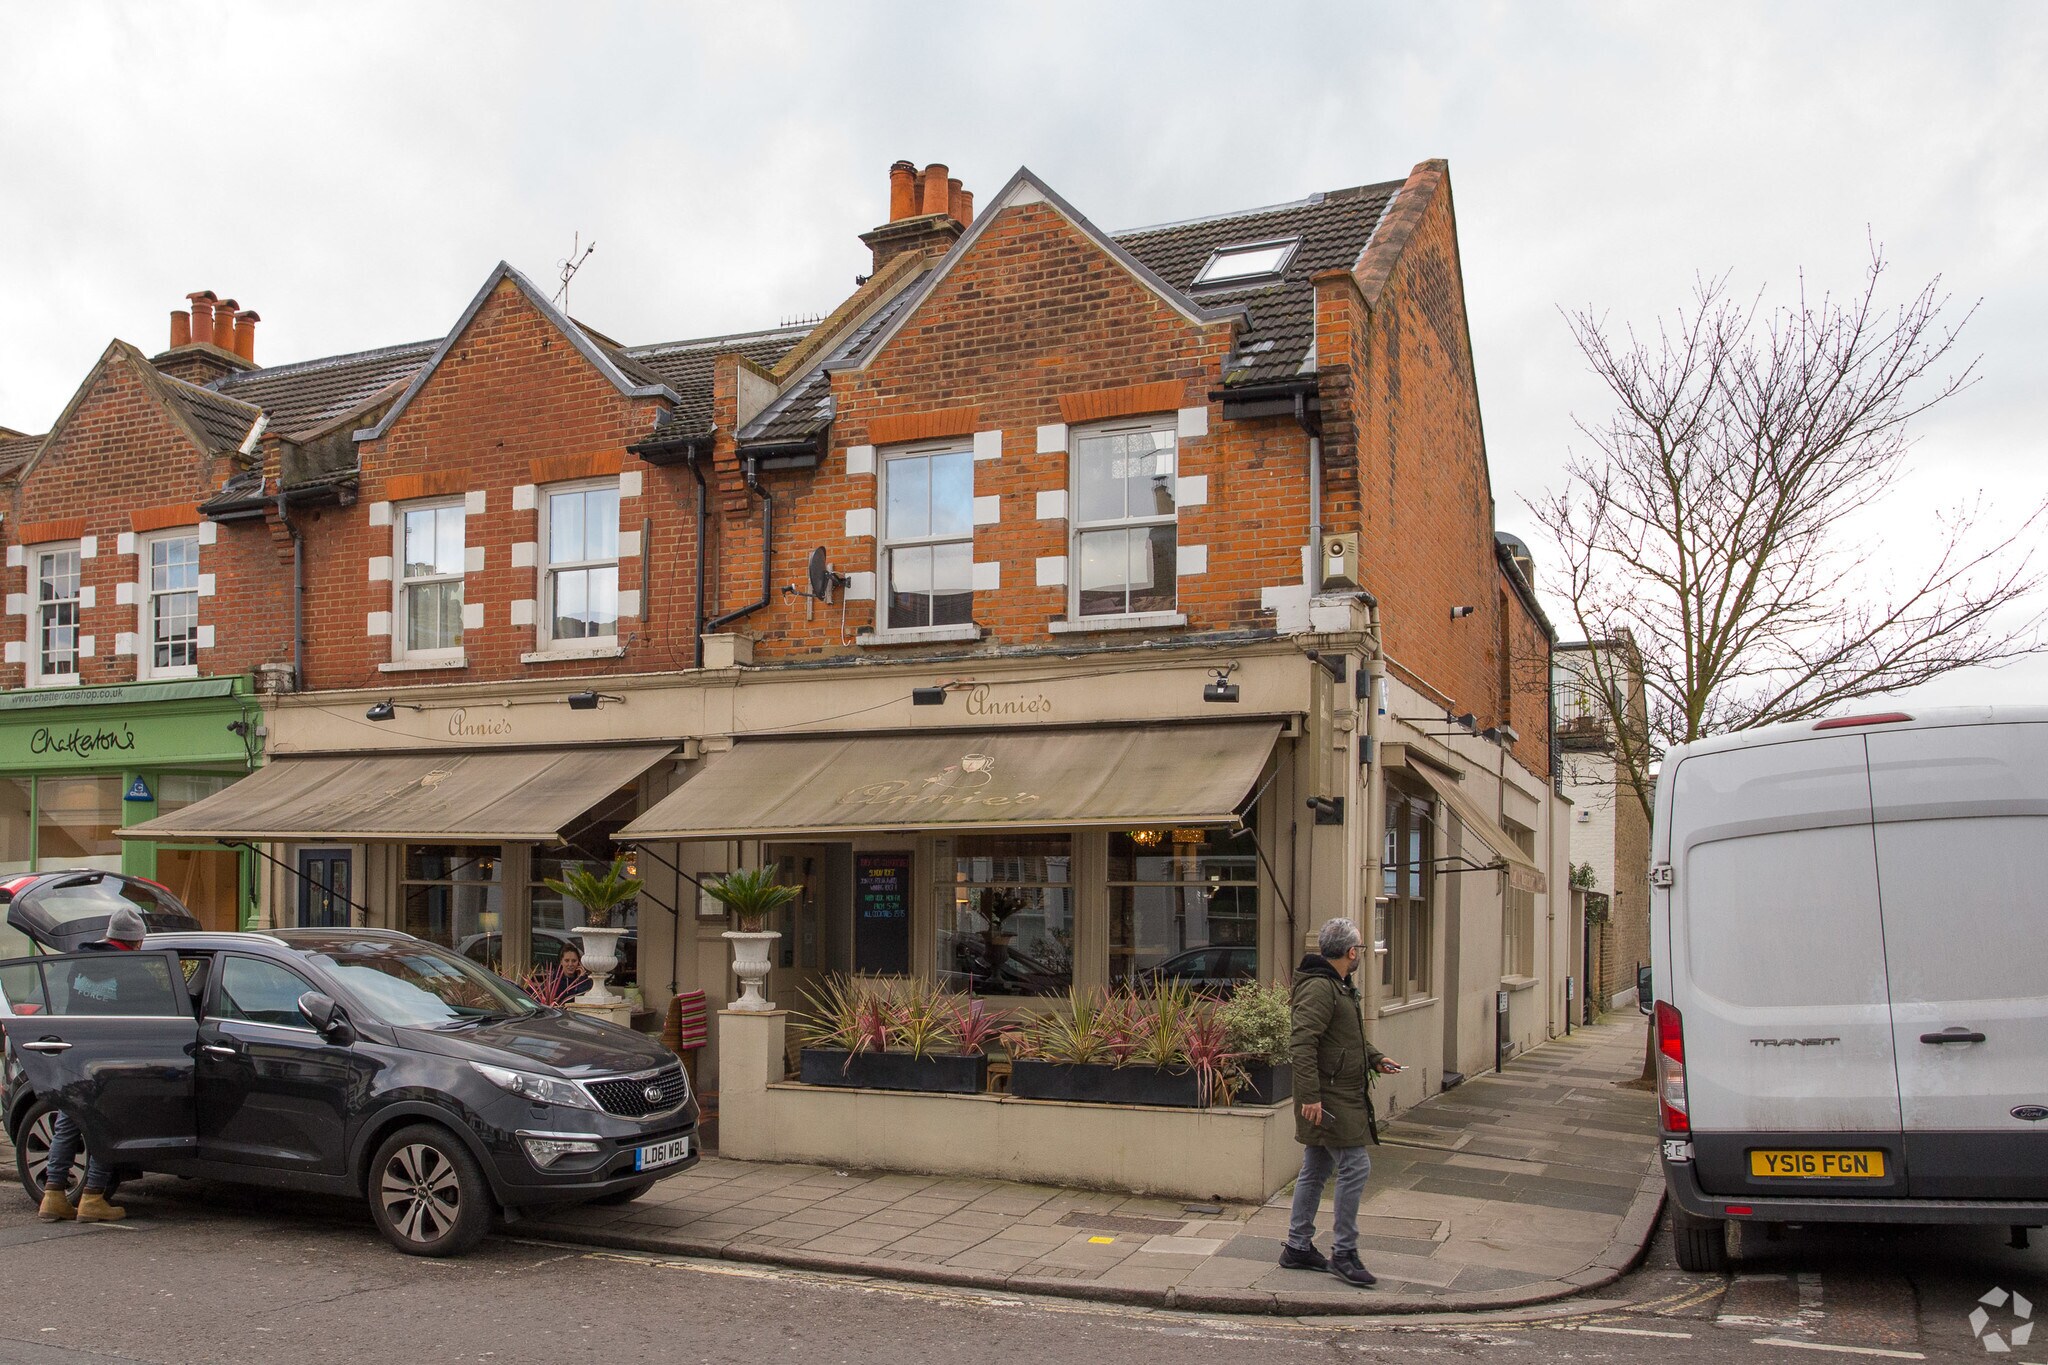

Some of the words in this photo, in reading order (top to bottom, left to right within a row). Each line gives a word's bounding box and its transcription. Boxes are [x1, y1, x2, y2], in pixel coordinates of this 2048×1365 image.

[965, 682, 1051, 715] Annie's
[448, 707, 512, 736] Annie's
[30, 722, 135, 758] Chatterton's
[1750, 1037, 1840, 1047] TRANSIT
[644, 1147, 667, 1165] LD61
[668, 1141, 685, 1159] WBL
[1765, 1154, 1816, 1173] YS16
[1822, 1154, 1869, 1173] FGN
